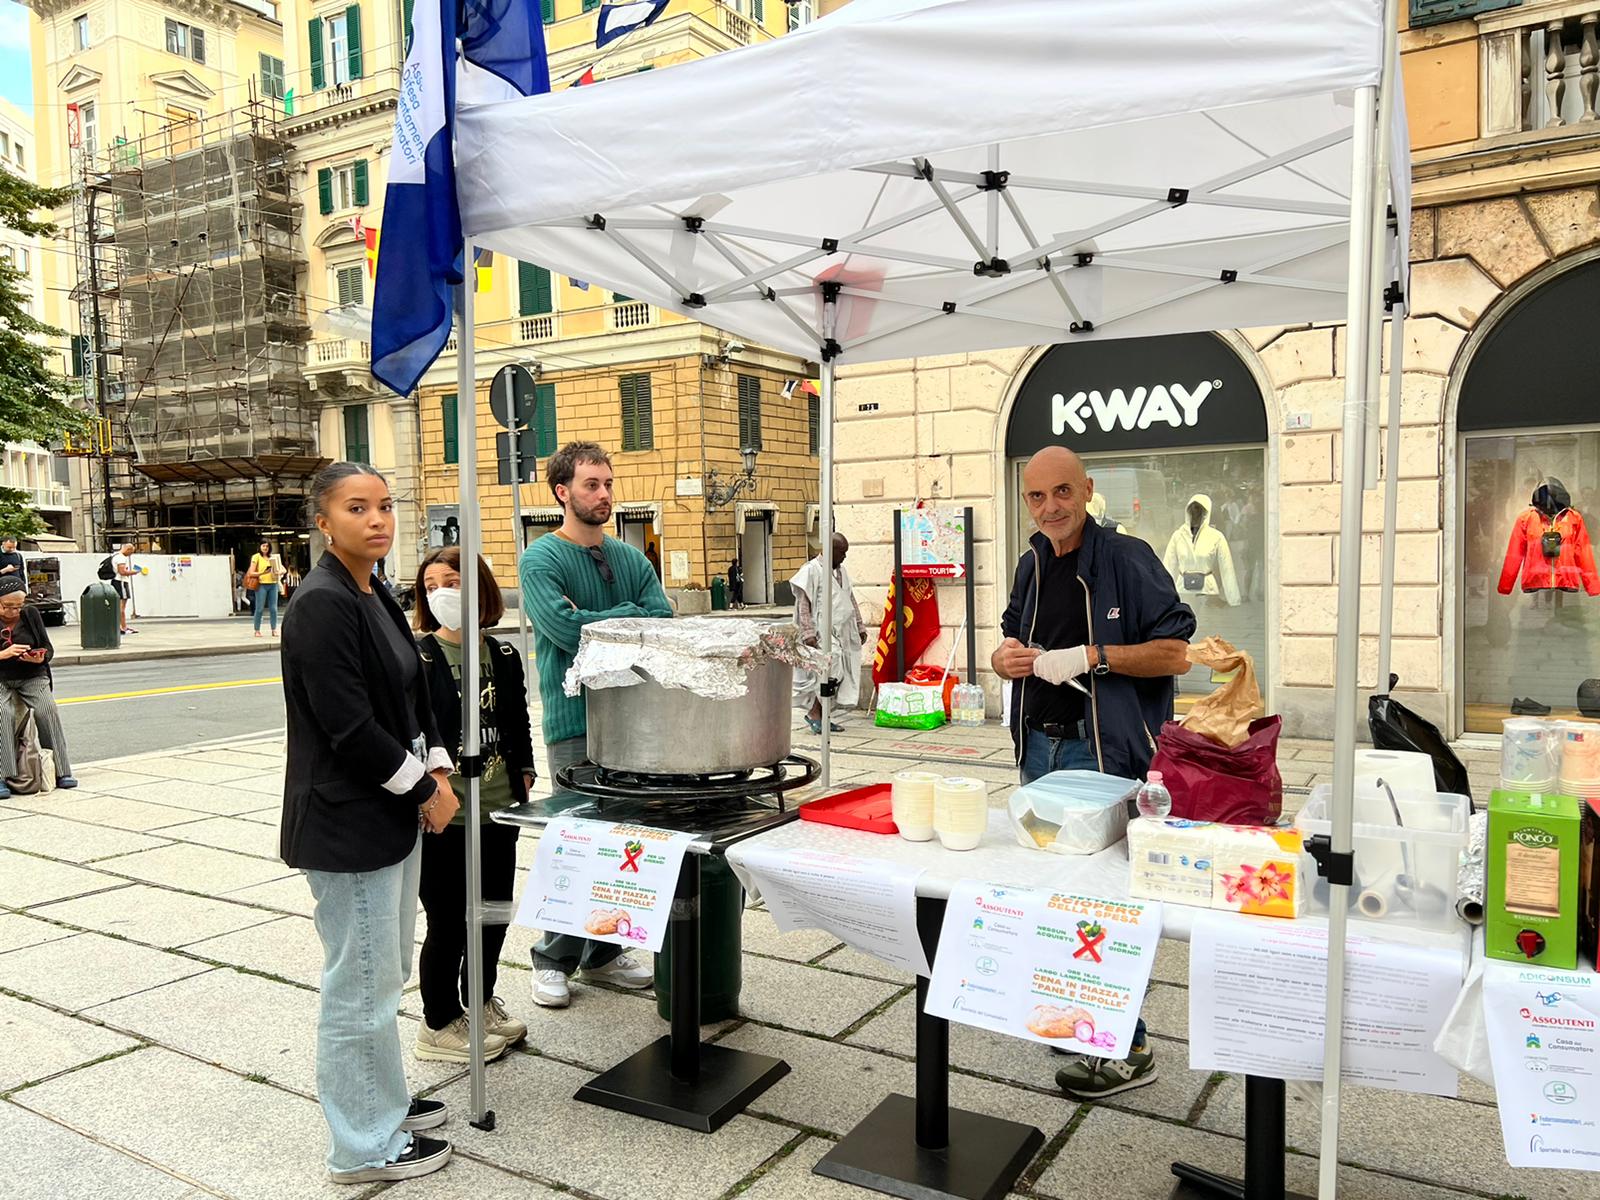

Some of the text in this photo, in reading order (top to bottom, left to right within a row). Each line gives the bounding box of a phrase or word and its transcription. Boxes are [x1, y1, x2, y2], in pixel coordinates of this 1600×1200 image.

[402, 68, 420, 110] Difesa
[1513, 832, 1553, 844] RONCO
[623, 890, 648, 900] PIAZZA
[982, 903, 1024, 917] ASSOUTENTI
[1050, 895, 1141, 917] SCIOPERO
[1047, 901, 1139, 925] DELLA SPESA
[1036, 925, 1067, 936] NESSUN
[1036, 932, 1074, 943] ACQUISTO
[1112, 940, 1142, 951] PER UN
[1034, 967, 1131, 992] LARGO LANFRANCO GENOVA
[1519, 972, 1592, 985] ADICONSUM
[1032, 974, 1062, 986] CENA
[1066, 981, 1077, 990] IN
[1080, 984, 1119, 998] PIAZZA
[1069, 990, 1076, 998] E
[1532, 1016, 1594, 1028] ASSOUTENTI
[1548, 1043, 1594, 1053] Consumatore
[1556, 1038, 1574, 1046] Casa
